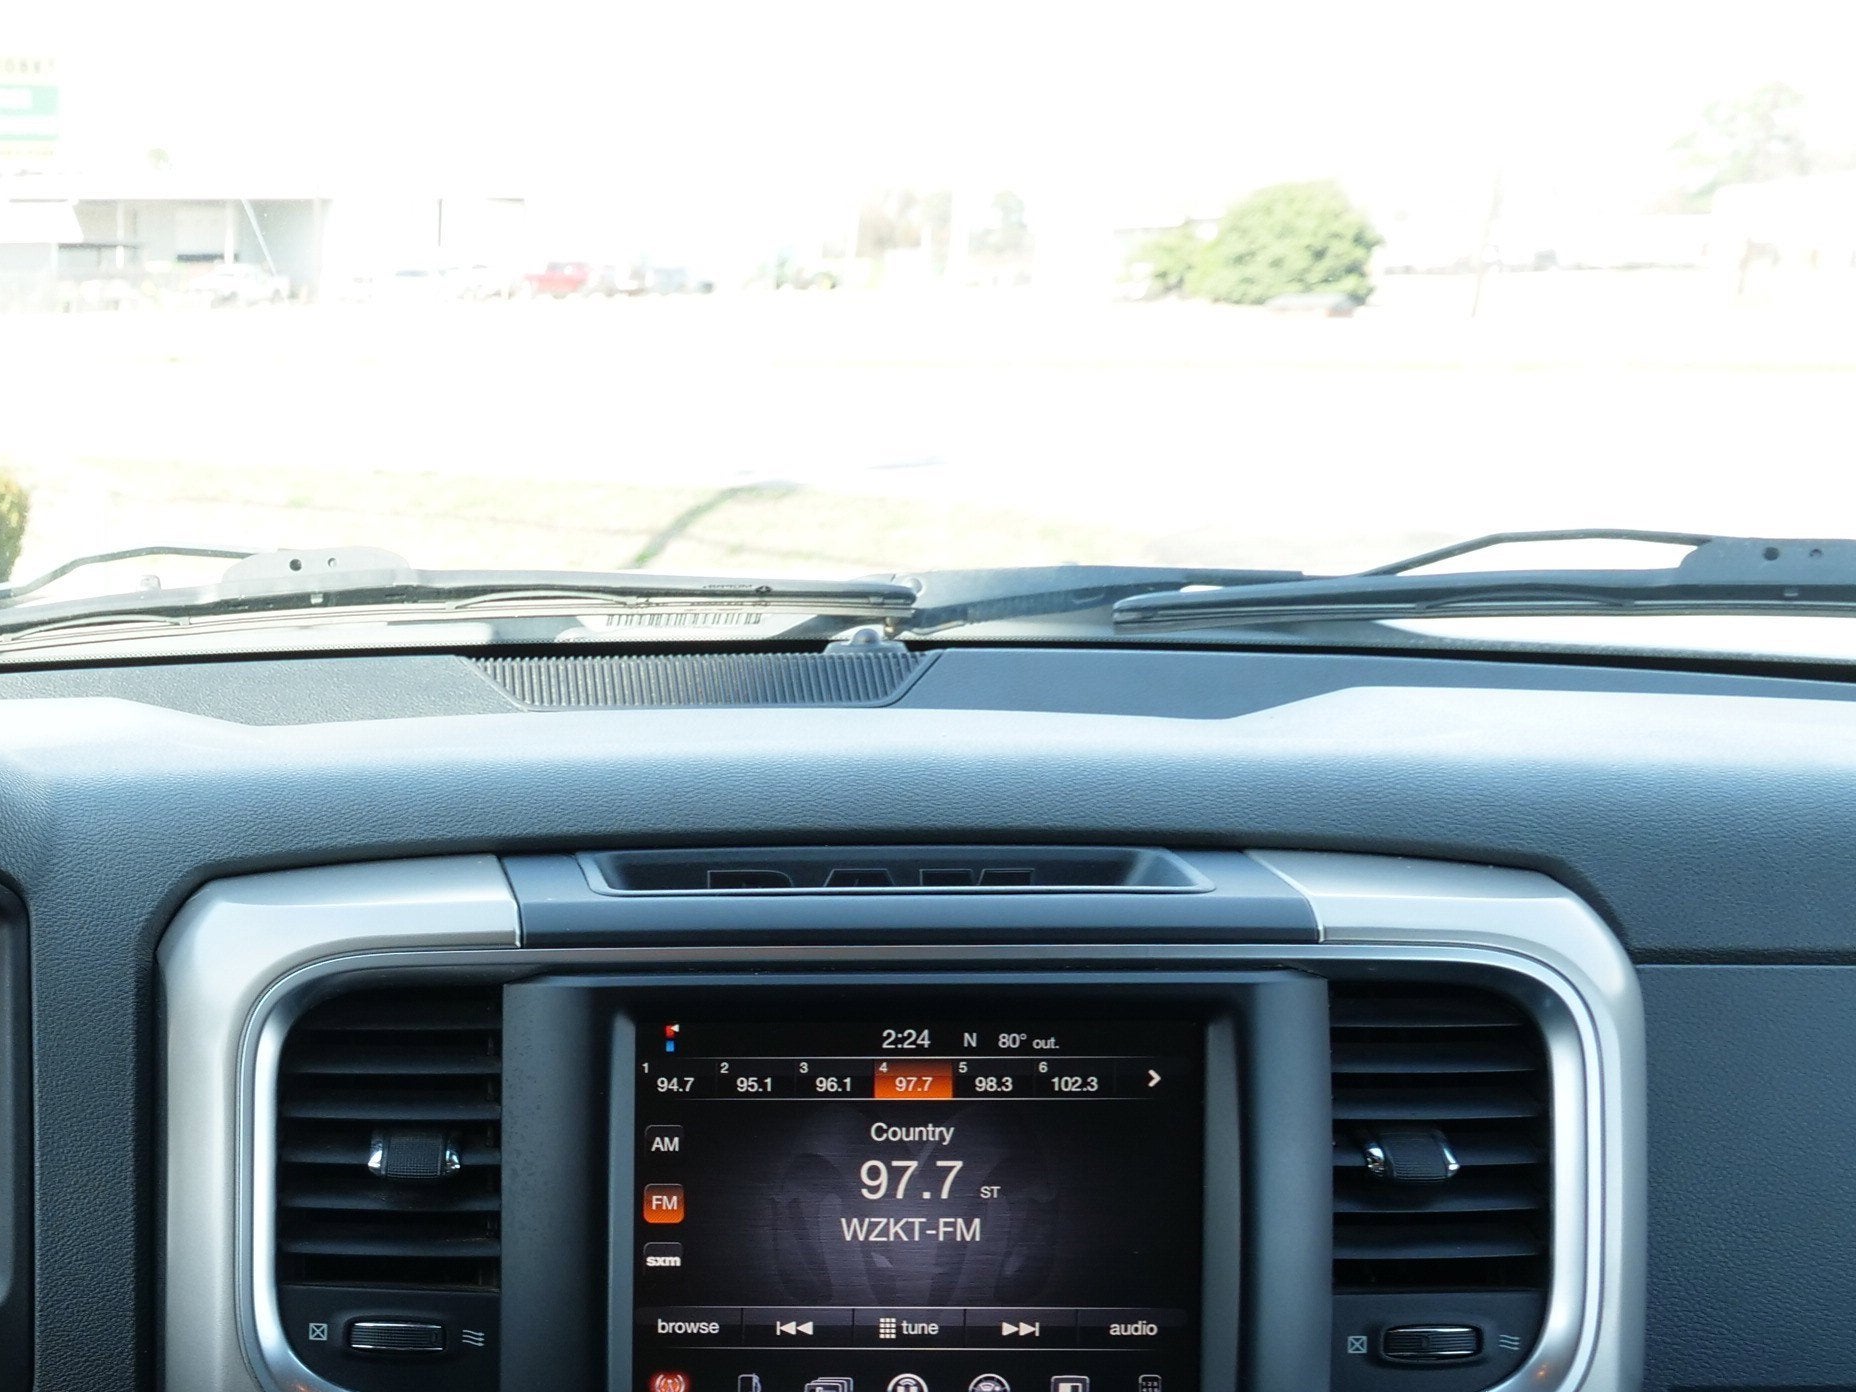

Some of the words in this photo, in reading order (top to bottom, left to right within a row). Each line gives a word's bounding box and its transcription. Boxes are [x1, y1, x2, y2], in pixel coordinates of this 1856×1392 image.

[882, 1029, 931, 1049] 2:24
[964, 1033, 977, 1047] N
[998, 1033, 1027, 1048] 80°
[1032, 1036, 1060, 1049] out.
[642, 1063, 649, 1073] 1
[720, 1062, 729, 1073] 2
[799, 1062, 809, 1073] 3
[879, 1062, 889, 1073] 4
[958, 1062, 968, 1073] 5
[1038, 1062, 1048, 1073] 6
[657, 1077, 694, 1092] 94.7
[736, 1077, 772, 1092] 95.1
[815, 1077, 852, 1092] 96.1
[895, 1077, 933, 1092] 97.7
[974, 1077, 1013, 1092] 98.3
[1050, 1077, 1099, 1092] 102.3
[870, 1122, 955, 1145] Country
[650, 1137, 680, 1152] AM
[860, 1160, 964, 1200] 97.7
[980, 1185, 1001, 1199] ST
[651, 1196, 678, 1211] FM
[841, 1218, 982, 1242] WZKT-FM
[646, 1255, 681, 1267] sxm
[657, 1319, 720, 1335] browse
[902, 1320, 939, 1336] tune
[1109, 1320, 1159, 1336] audio
